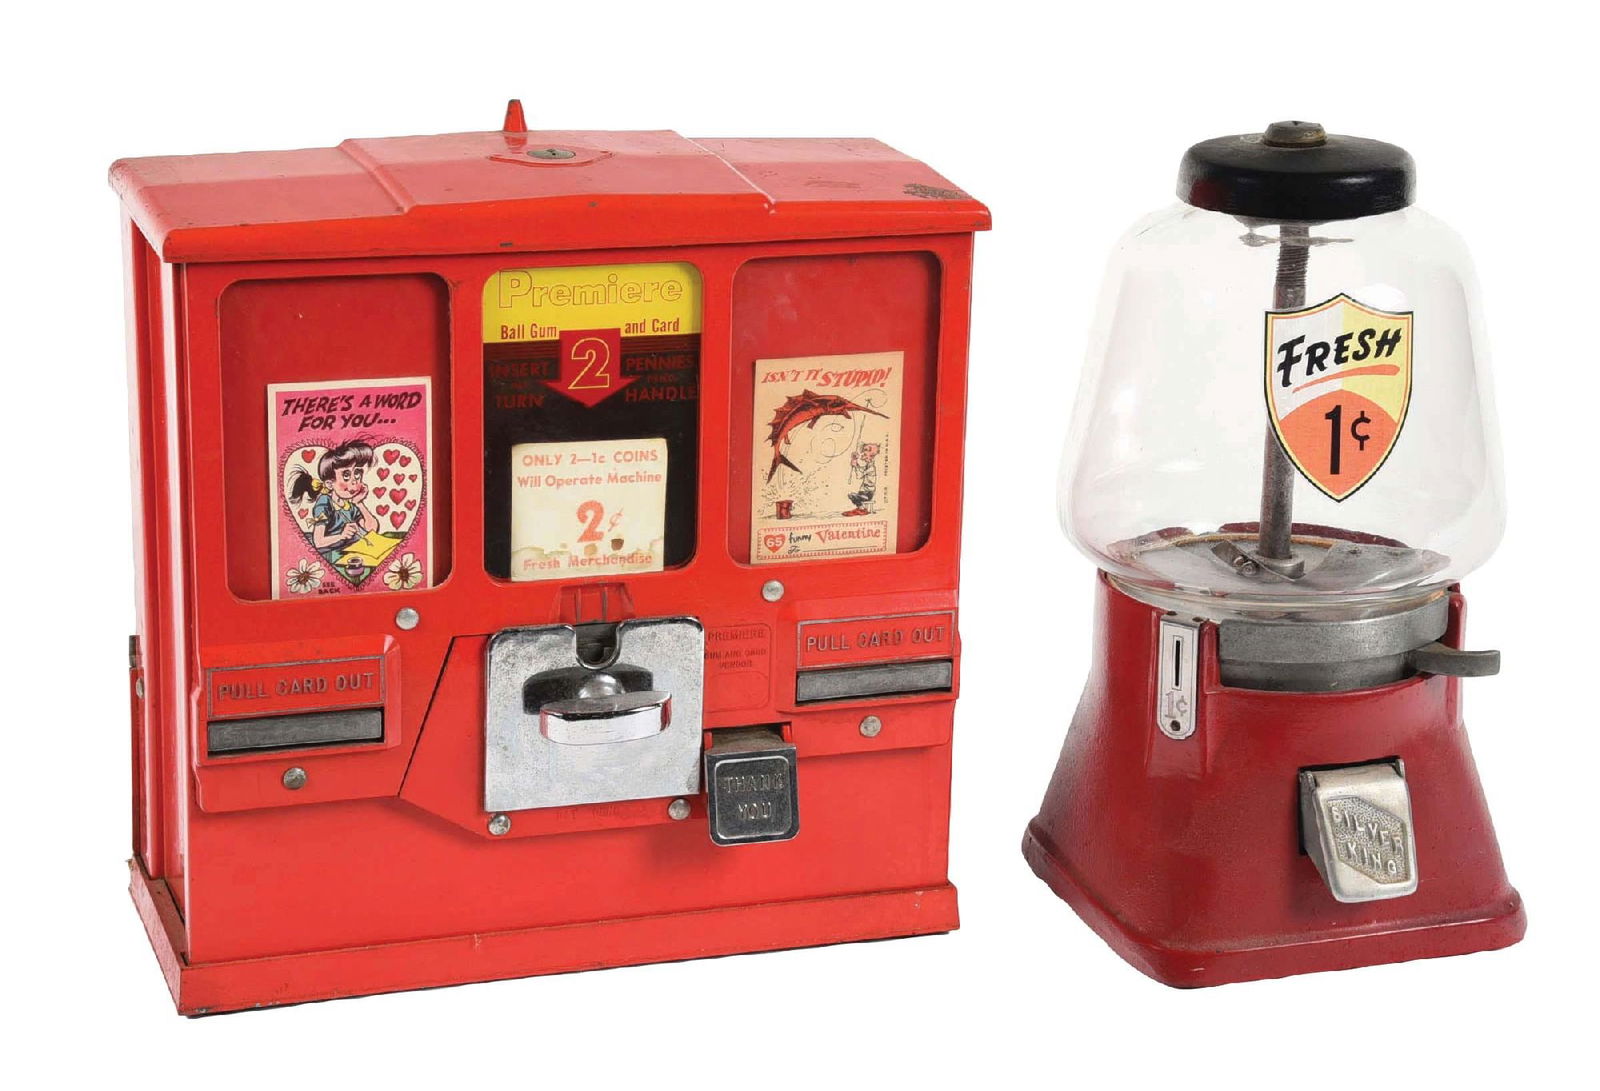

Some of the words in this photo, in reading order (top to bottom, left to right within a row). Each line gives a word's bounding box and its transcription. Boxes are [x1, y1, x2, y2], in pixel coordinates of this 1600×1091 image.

[499, 269, 683, 308] Premiere
[501, 324, 525, 340] Ball
[530, 323, 557, 338] Gum
[624, 319, 646, 334] and
[652, 318, 680, 333] Card
[568, 337, 610, 390] 2
[1277, 327, 1402, 388] FRESH
[761, 370, 804, 384] ISN'T
[805, 368, 822, 381] IT
[817, 367, 893, 388] STUPID!
[282, 394, 353, 416] THERE'S
[359, 396, 371, 408] A
[374, 391, 423, 410] WORD
[625, 385, 698, 402] HANDLE
[298, 414, 336, 432] FOR
[342, 412, 397, 430] YOU...
[1325, 404, 1371, 475] 1¢
[522, 454, 562, 467] ONLY
[613, 450, 658, 463] COINS
[517, 475, 541, 487] Will
[545, 474, 602, 489] Operate
[607, 471, 662, 484] Machine
[766, 537, 783, 547] 65
[815, 528, 881, 544] Valentine
[523, 558, 560, 571] Fresh
[568, 553, 652, 568] Merchandise
[807, 635, 850, 652] PULL
[857, 630, 904, 648] CARD
[912, 626, 945, 643] OUT
[218, 683, 270, 701] PULL
[276, 676, 329, 696] CARD
[336, 672, 374, 690] OUT
[1165, 691, 1187, 719] 1¢
[725, 773, 785, 793] THANK
[737, 801, 772, 819] YOU
[1331, 806, 1404, 856] SILVER
[1347, 841, 1397, 874] KING
